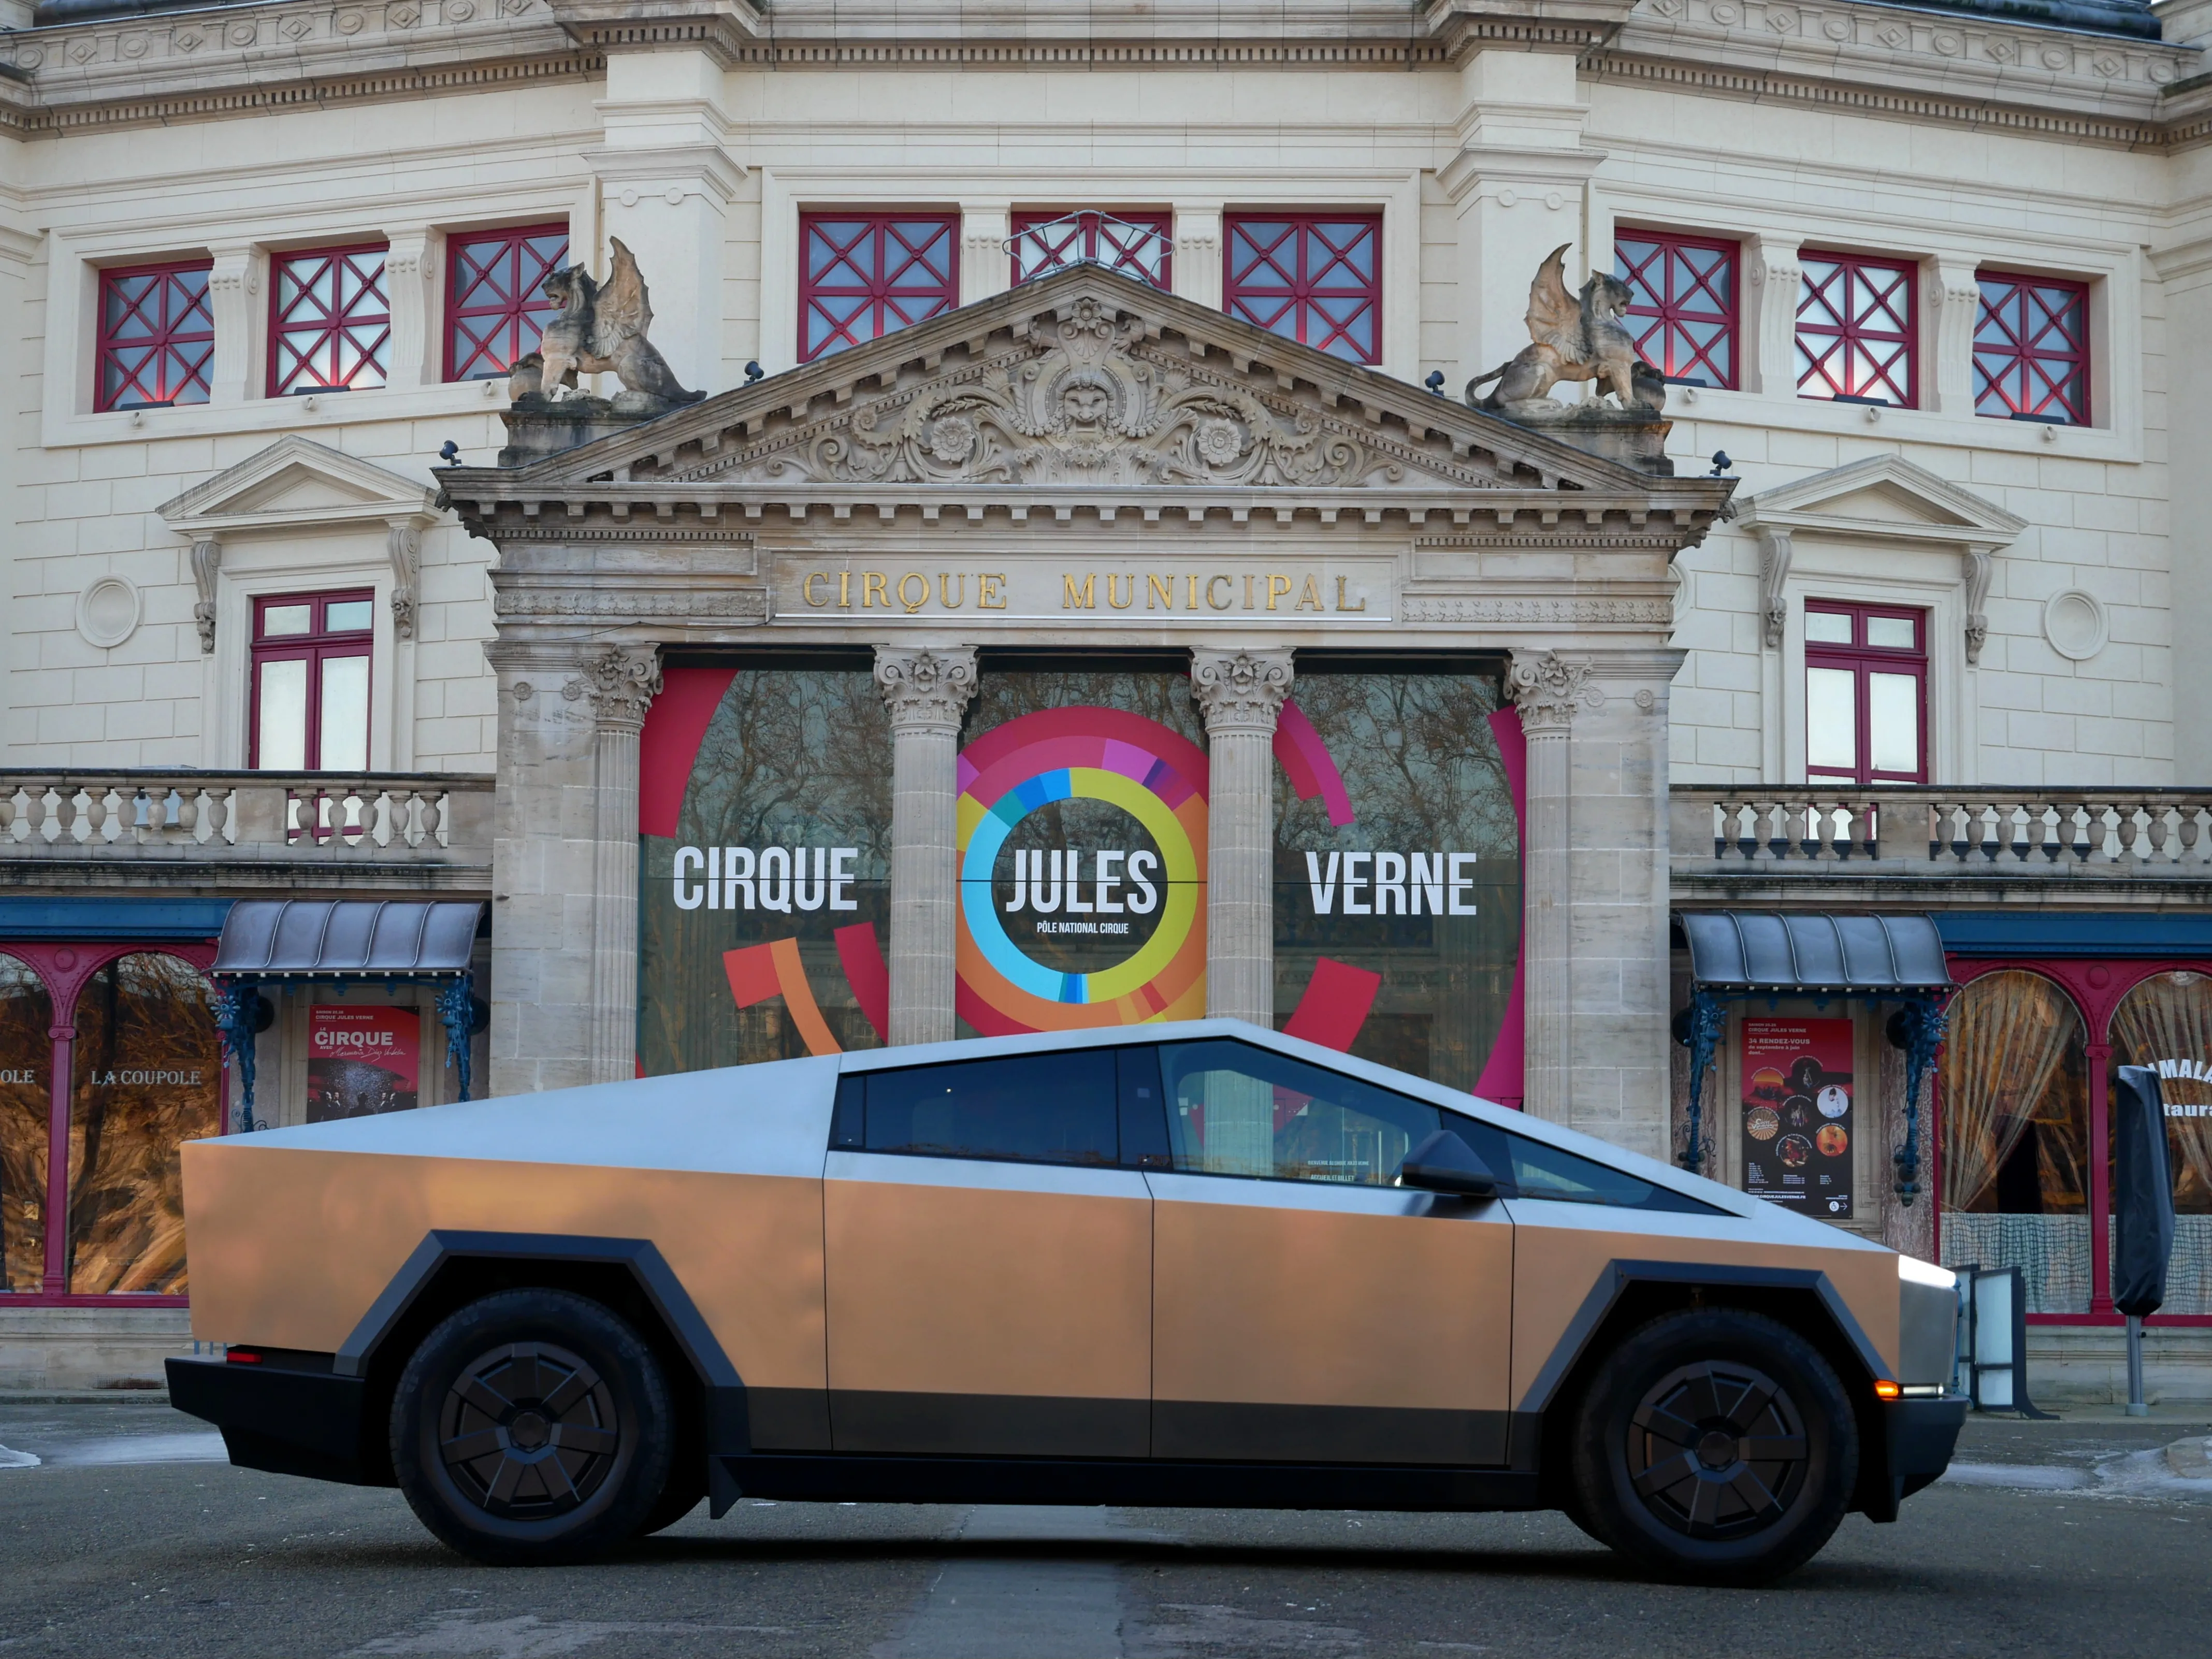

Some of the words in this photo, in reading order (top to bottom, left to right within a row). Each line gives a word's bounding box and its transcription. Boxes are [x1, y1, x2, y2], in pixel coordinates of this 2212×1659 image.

[803, 571, 1006, 613] CIRQUE
[1063, 573, 1365, 611] MUNICIPAL
[673, 846, 858, 914] CIRQUE
[1006, 849, 1158, 914] JULES
[1306, 851, 1477, 915] VERNE
[1037, 920, 1057, 933] PÔLE
[1059, 922, 1098, 933] NATIONAL
[1100, 923, 1129, 934] CIRQUE
[314, 1031, 393, 1048] CIRQUE
[91, 1070, 117, 1087] LA
[121, 1070, 202, 1085] COUPOLE
